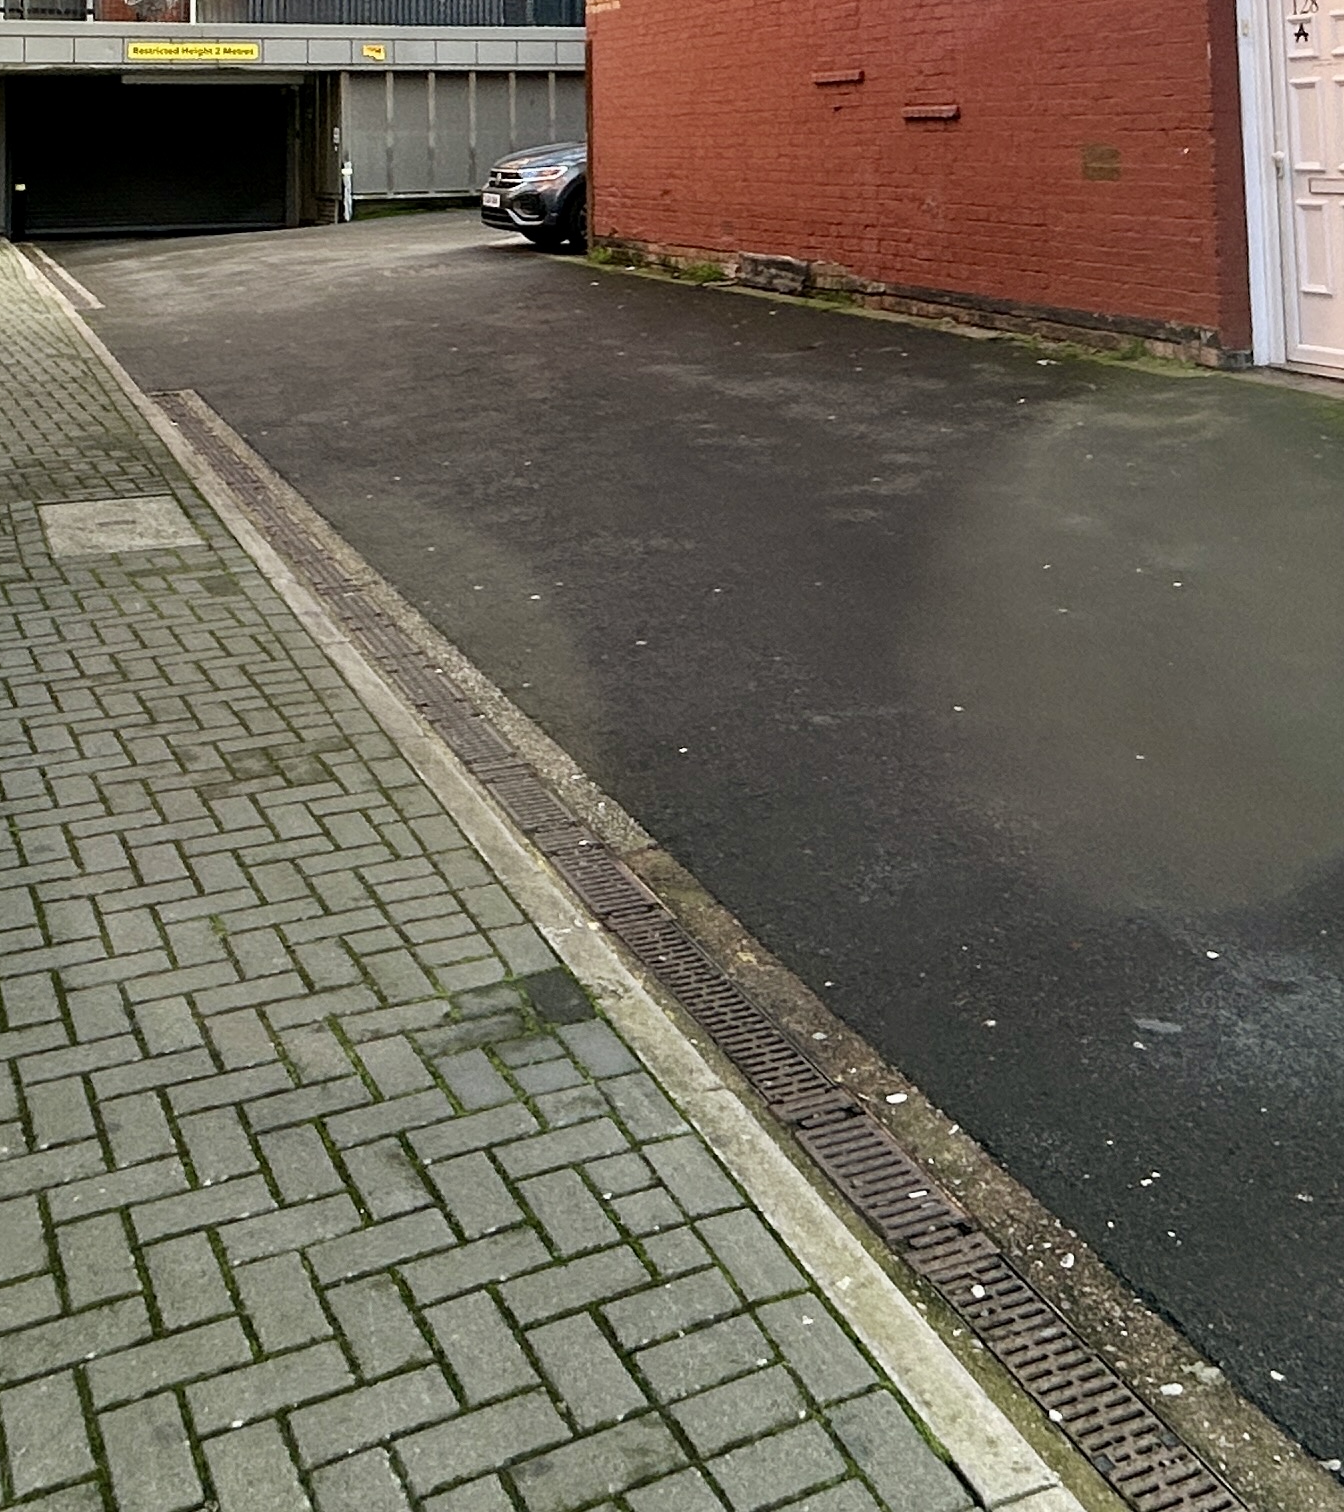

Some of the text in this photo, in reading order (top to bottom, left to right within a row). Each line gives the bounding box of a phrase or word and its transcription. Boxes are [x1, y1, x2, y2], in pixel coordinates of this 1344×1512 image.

[1293, 21, 1310, 44] A
[132, 46, 254, 57] Restricted Height 2 Metres
